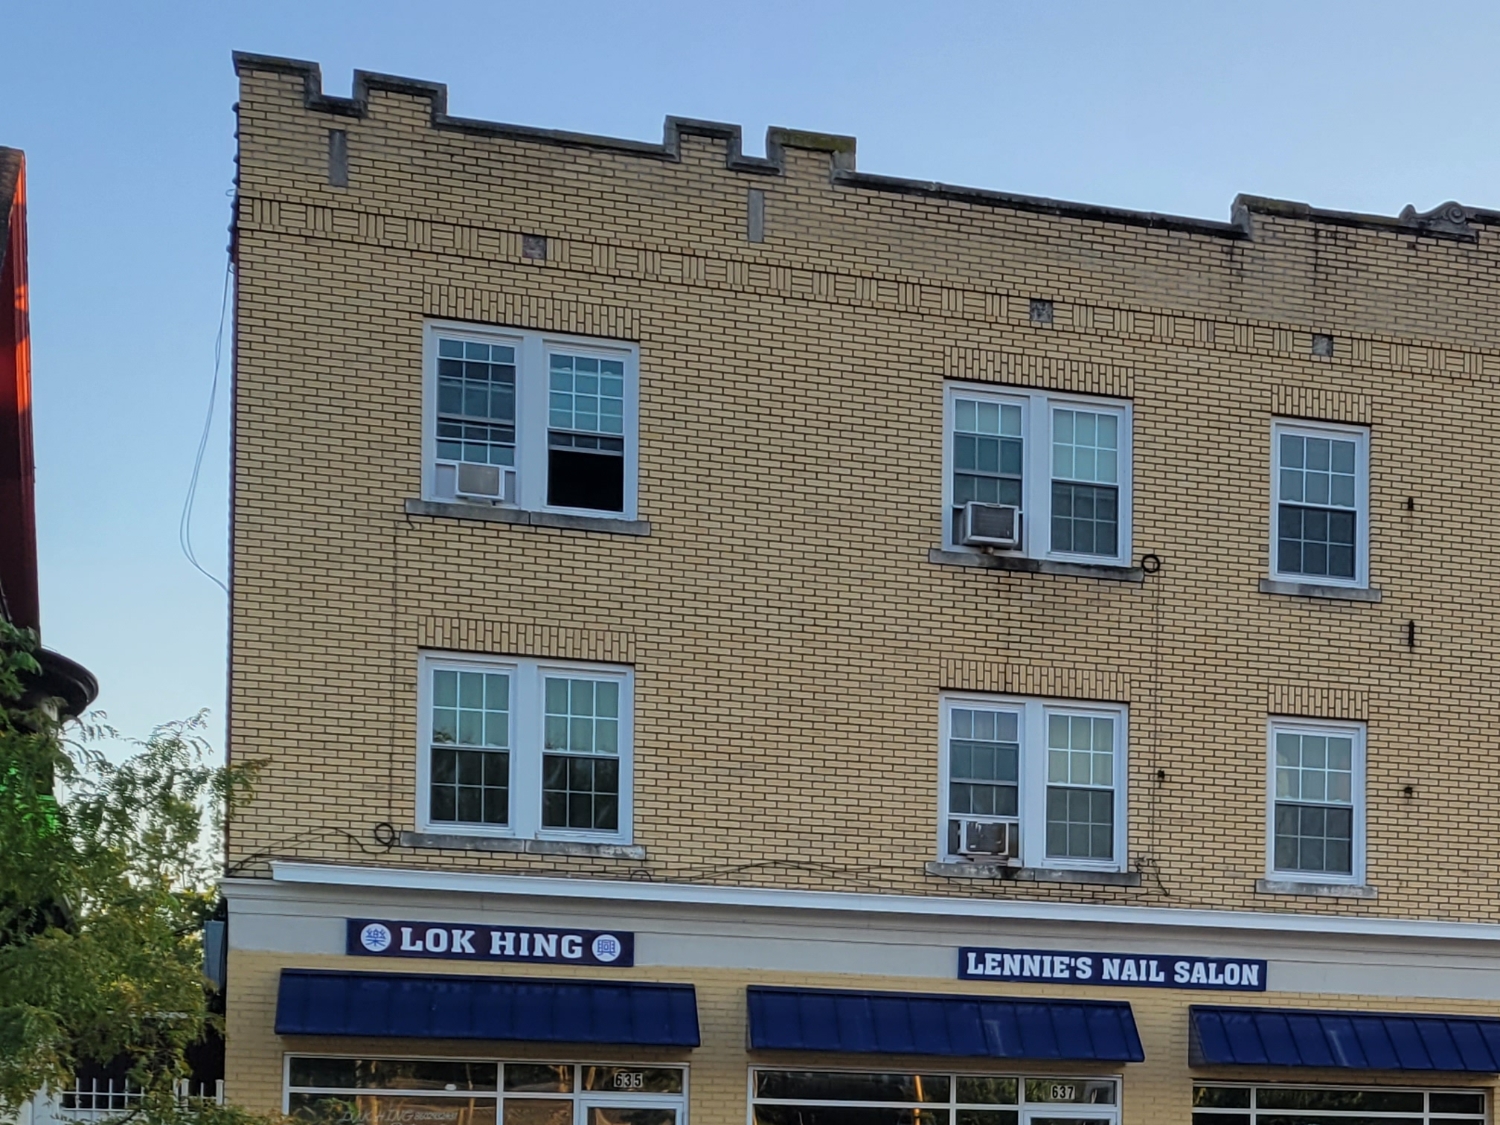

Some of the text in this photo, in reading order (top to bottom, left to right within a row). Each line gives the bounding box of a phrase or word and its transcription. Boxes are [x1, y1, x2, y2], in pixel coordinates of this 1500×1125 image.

[364, 926, 388, 948] 樂
[400, 927, 583, 959] LOK HING
[595, 938, 617, 958] 興
[967, 952, 1259, 986] LENNIE'S NAIL SALON
[615, 1073, 641, 1087] 635
[1052, 1085, 1074, 1099] 637
